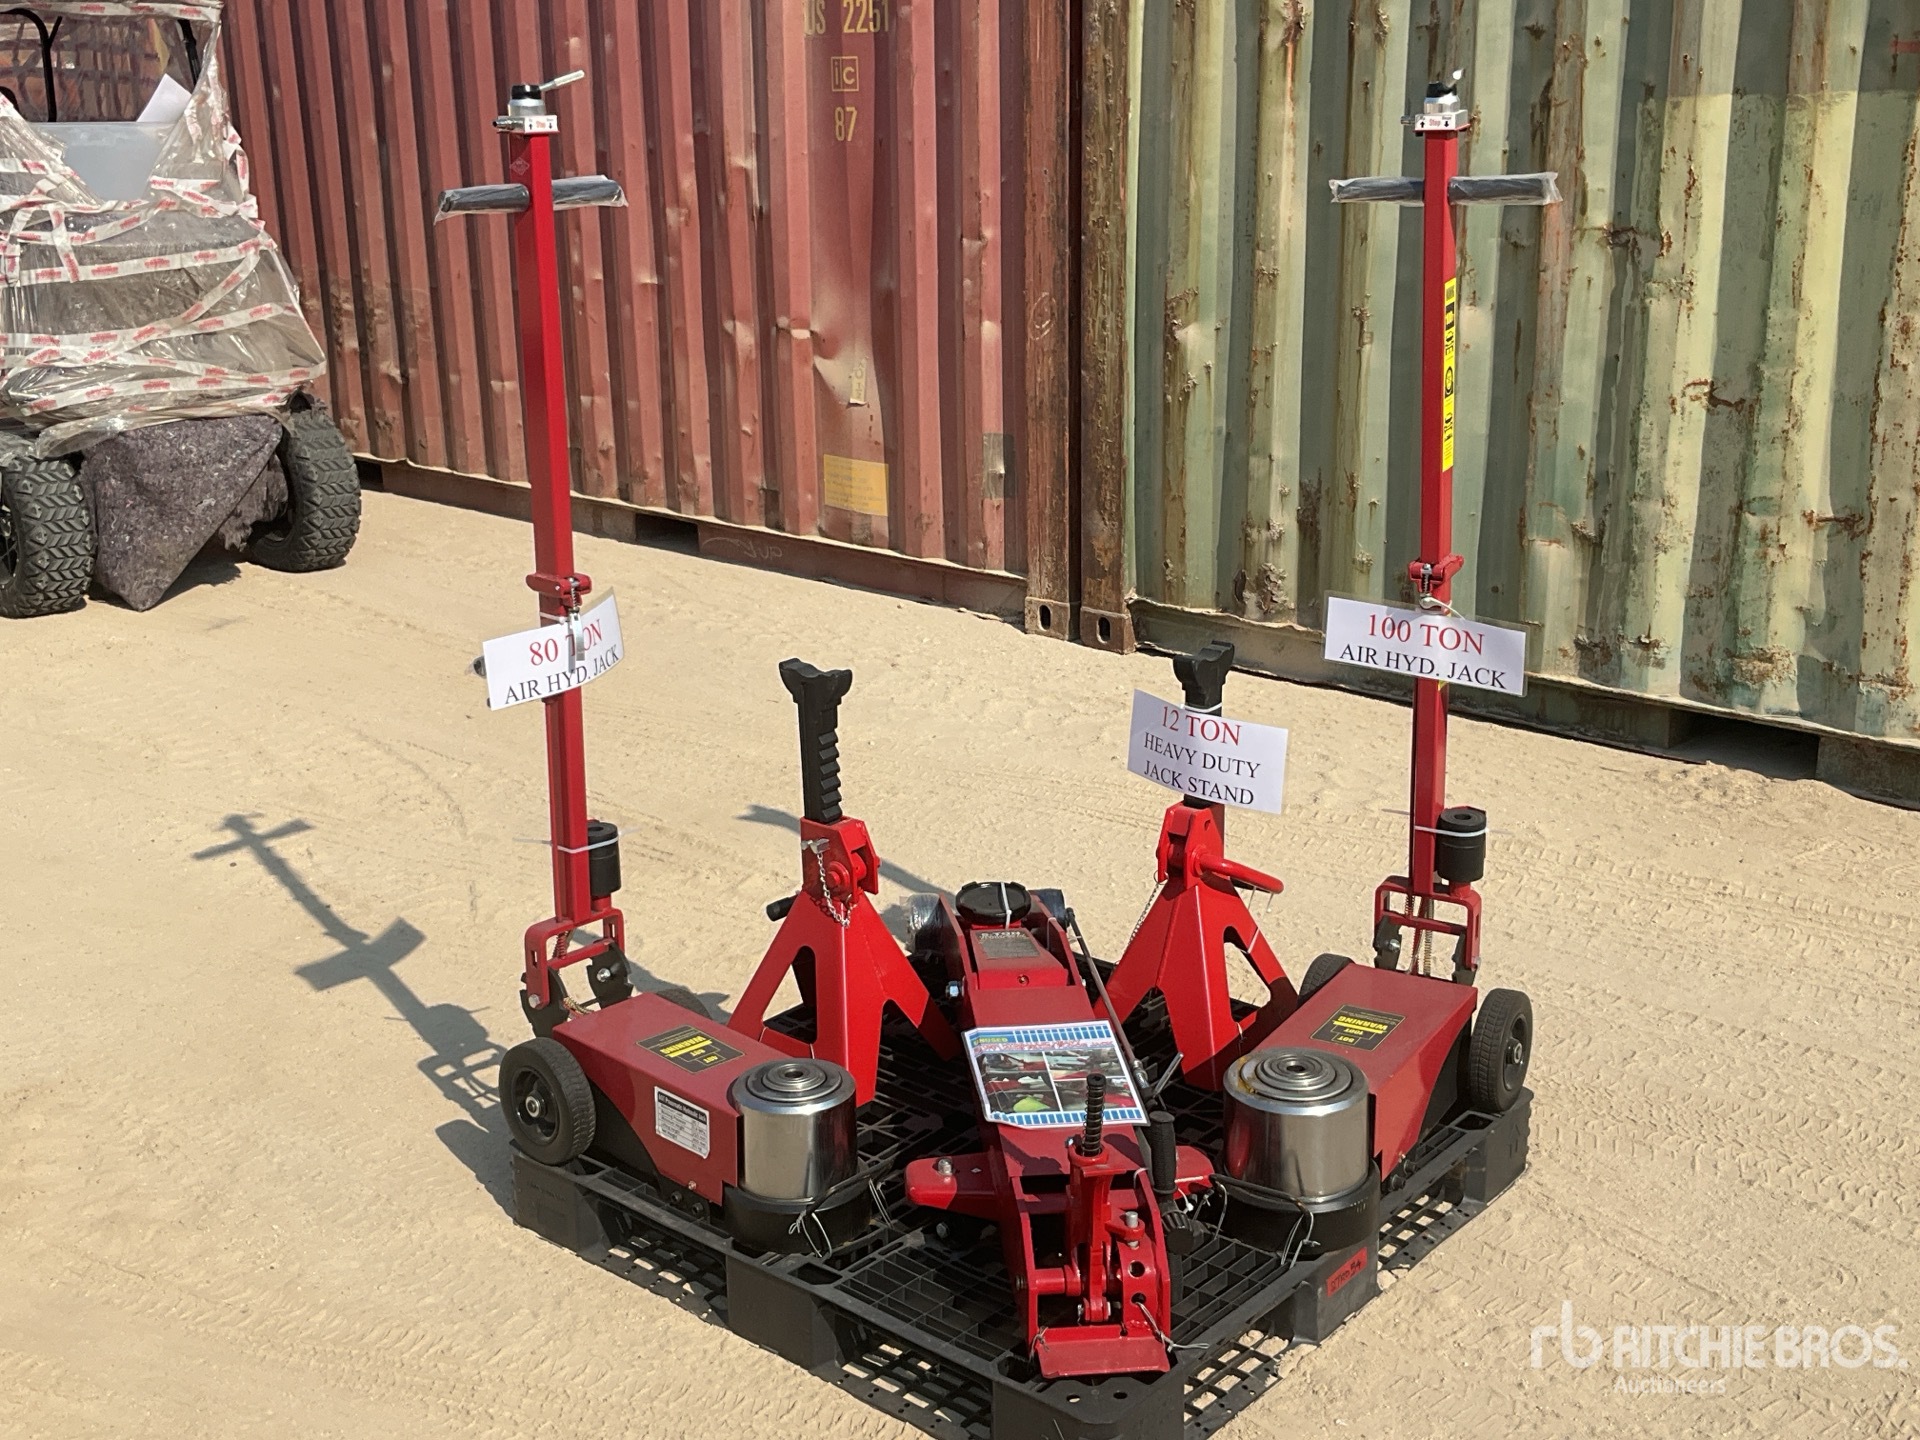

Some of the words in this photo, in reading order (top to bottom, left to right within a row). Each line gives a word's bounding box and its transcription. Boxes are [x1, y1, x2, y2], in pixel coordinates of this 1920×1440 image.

[835, 106, 857, 141] 87
[529, 638, 559, 666] 80
[1369, 613, 1411, 643] 100
[1420, 624, 1485, 655] TON
[505, 679, 542, 705] AIR
[547, 665, 592, 693] HYD.
[593, 644, 619, 676] JACK
[1339, 644, 1379, 666] AIR
[1385, 651, 1440, 676] HYD.
[1447, 662, 1507, 690] JACK
[1162, 706, 1179, 731] 12
[1185, 715, 1242, 746] TON
[1144, 732, 1197, 765] HEAVY
[1202, 752, 1261, 778] DUTY
[1144, 760, 1183, 790] JACK
[1188, 776, 1254, 805] STAND
[1337, 1015, 1389, 1031] WARNING
[660, 1035, 707, 1054] WARNING
